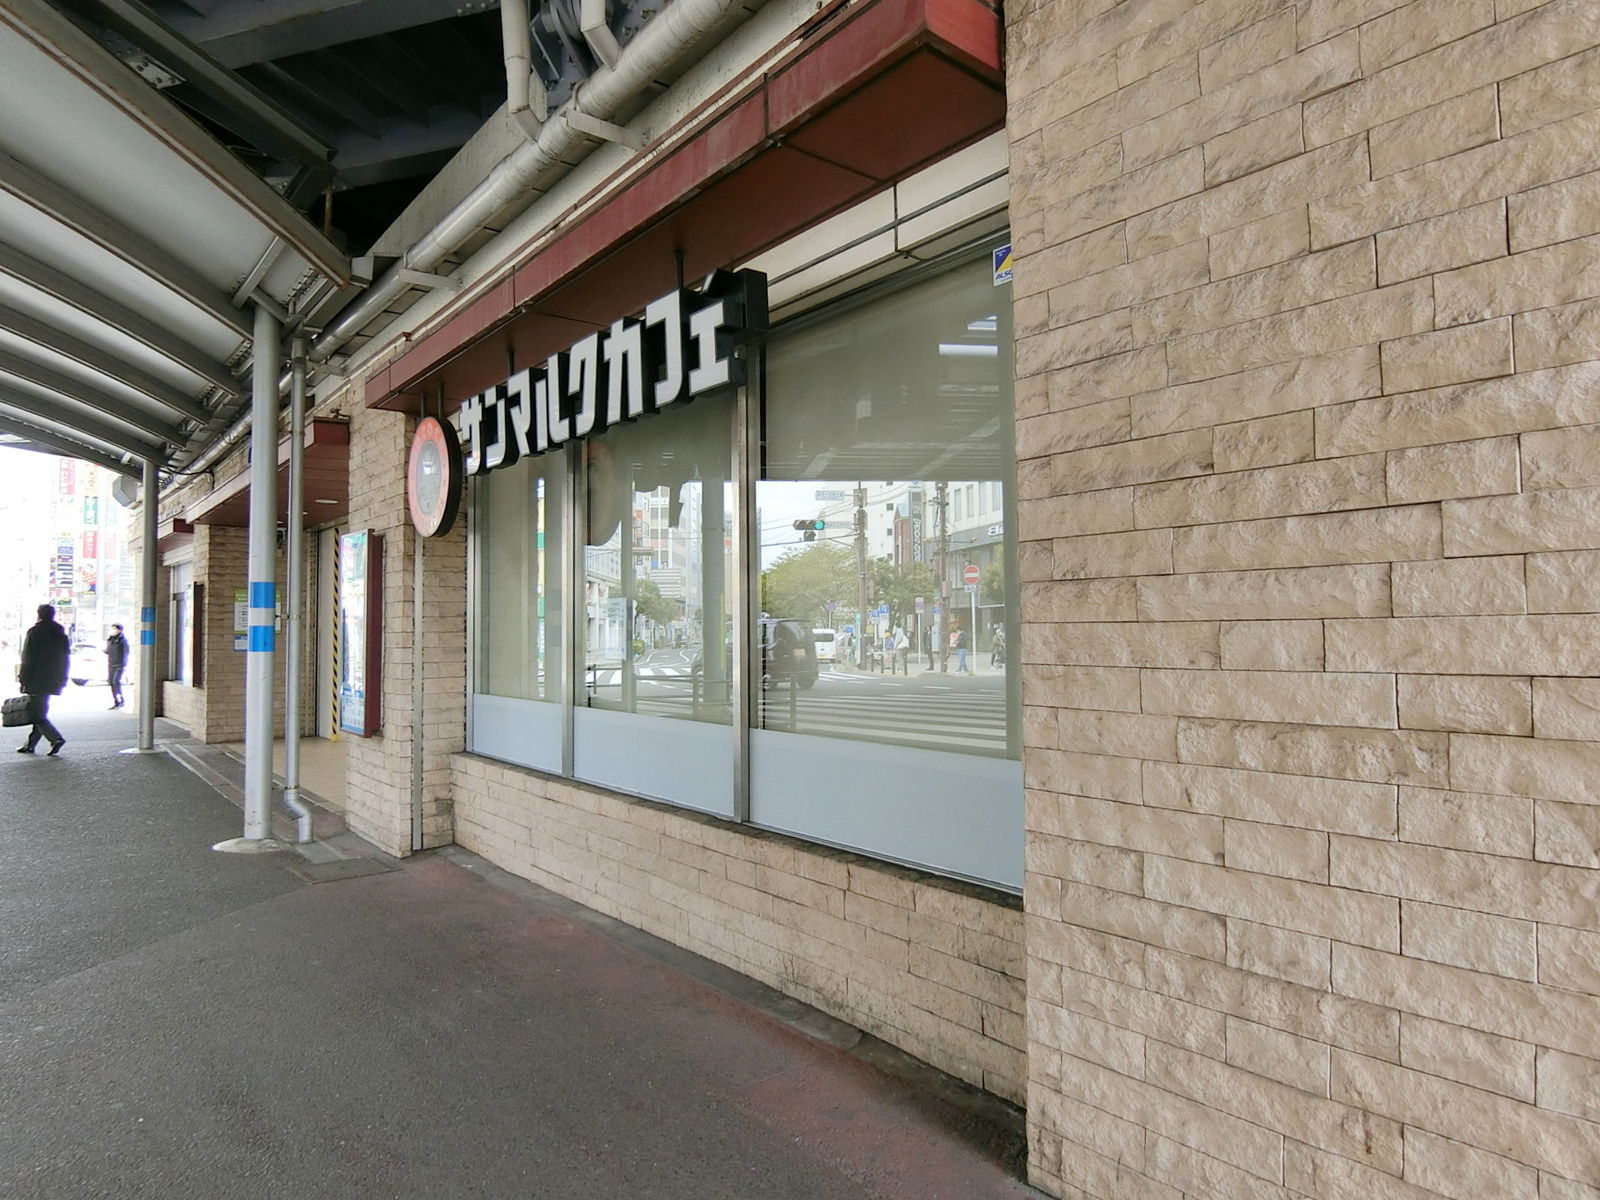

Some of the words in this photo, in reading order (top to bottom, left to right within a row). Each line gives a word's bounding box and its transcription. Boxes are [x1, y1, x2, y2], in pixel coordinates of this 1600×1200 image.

[459, 274, 730, 476] サンマルクカフェ
